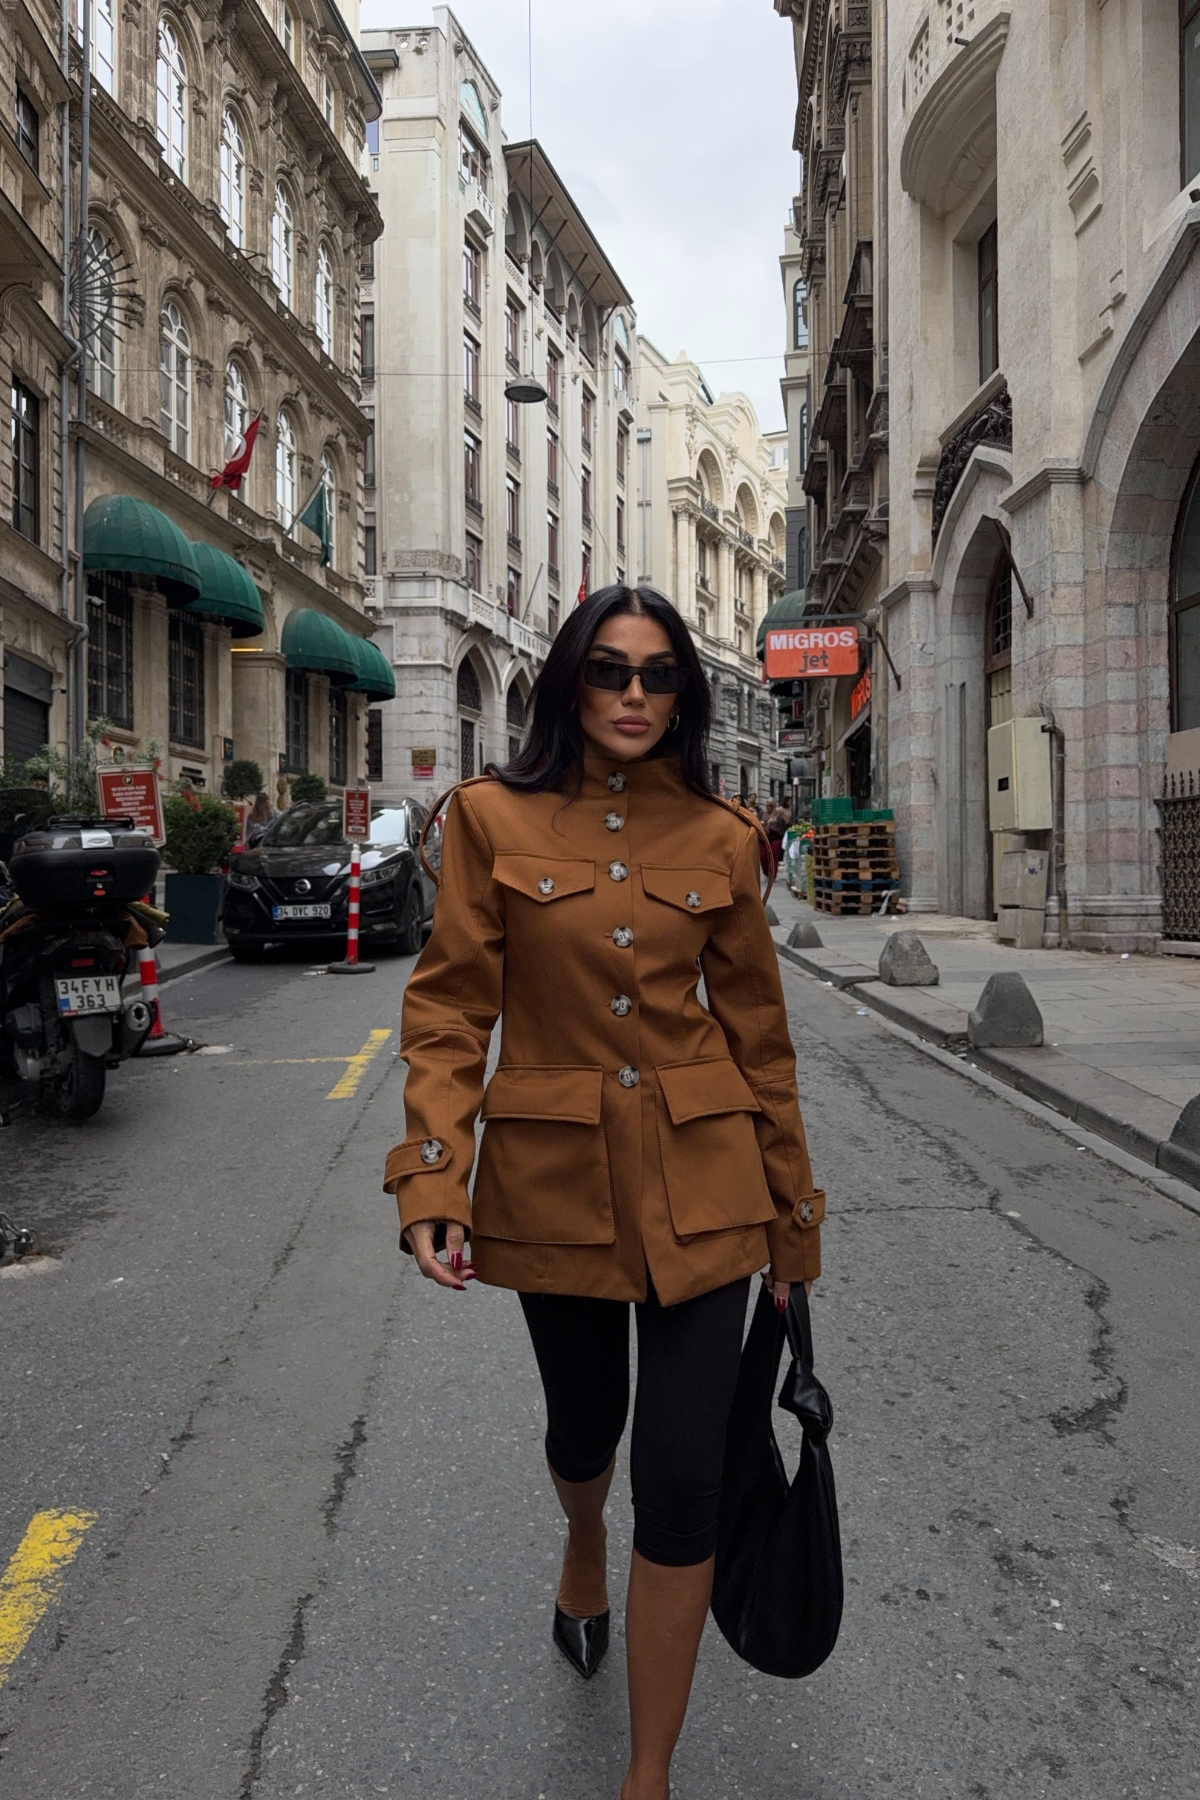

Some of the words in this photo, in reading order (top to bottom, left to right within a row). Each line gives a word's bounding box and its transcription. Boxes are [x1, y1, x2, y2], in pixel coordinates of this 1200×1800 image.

[798, 650, 829, 673] jet
[278, 907, 288, 916] 34
[312, 906, 329, 915] 920
[76, 993, 106, 1009] 363
